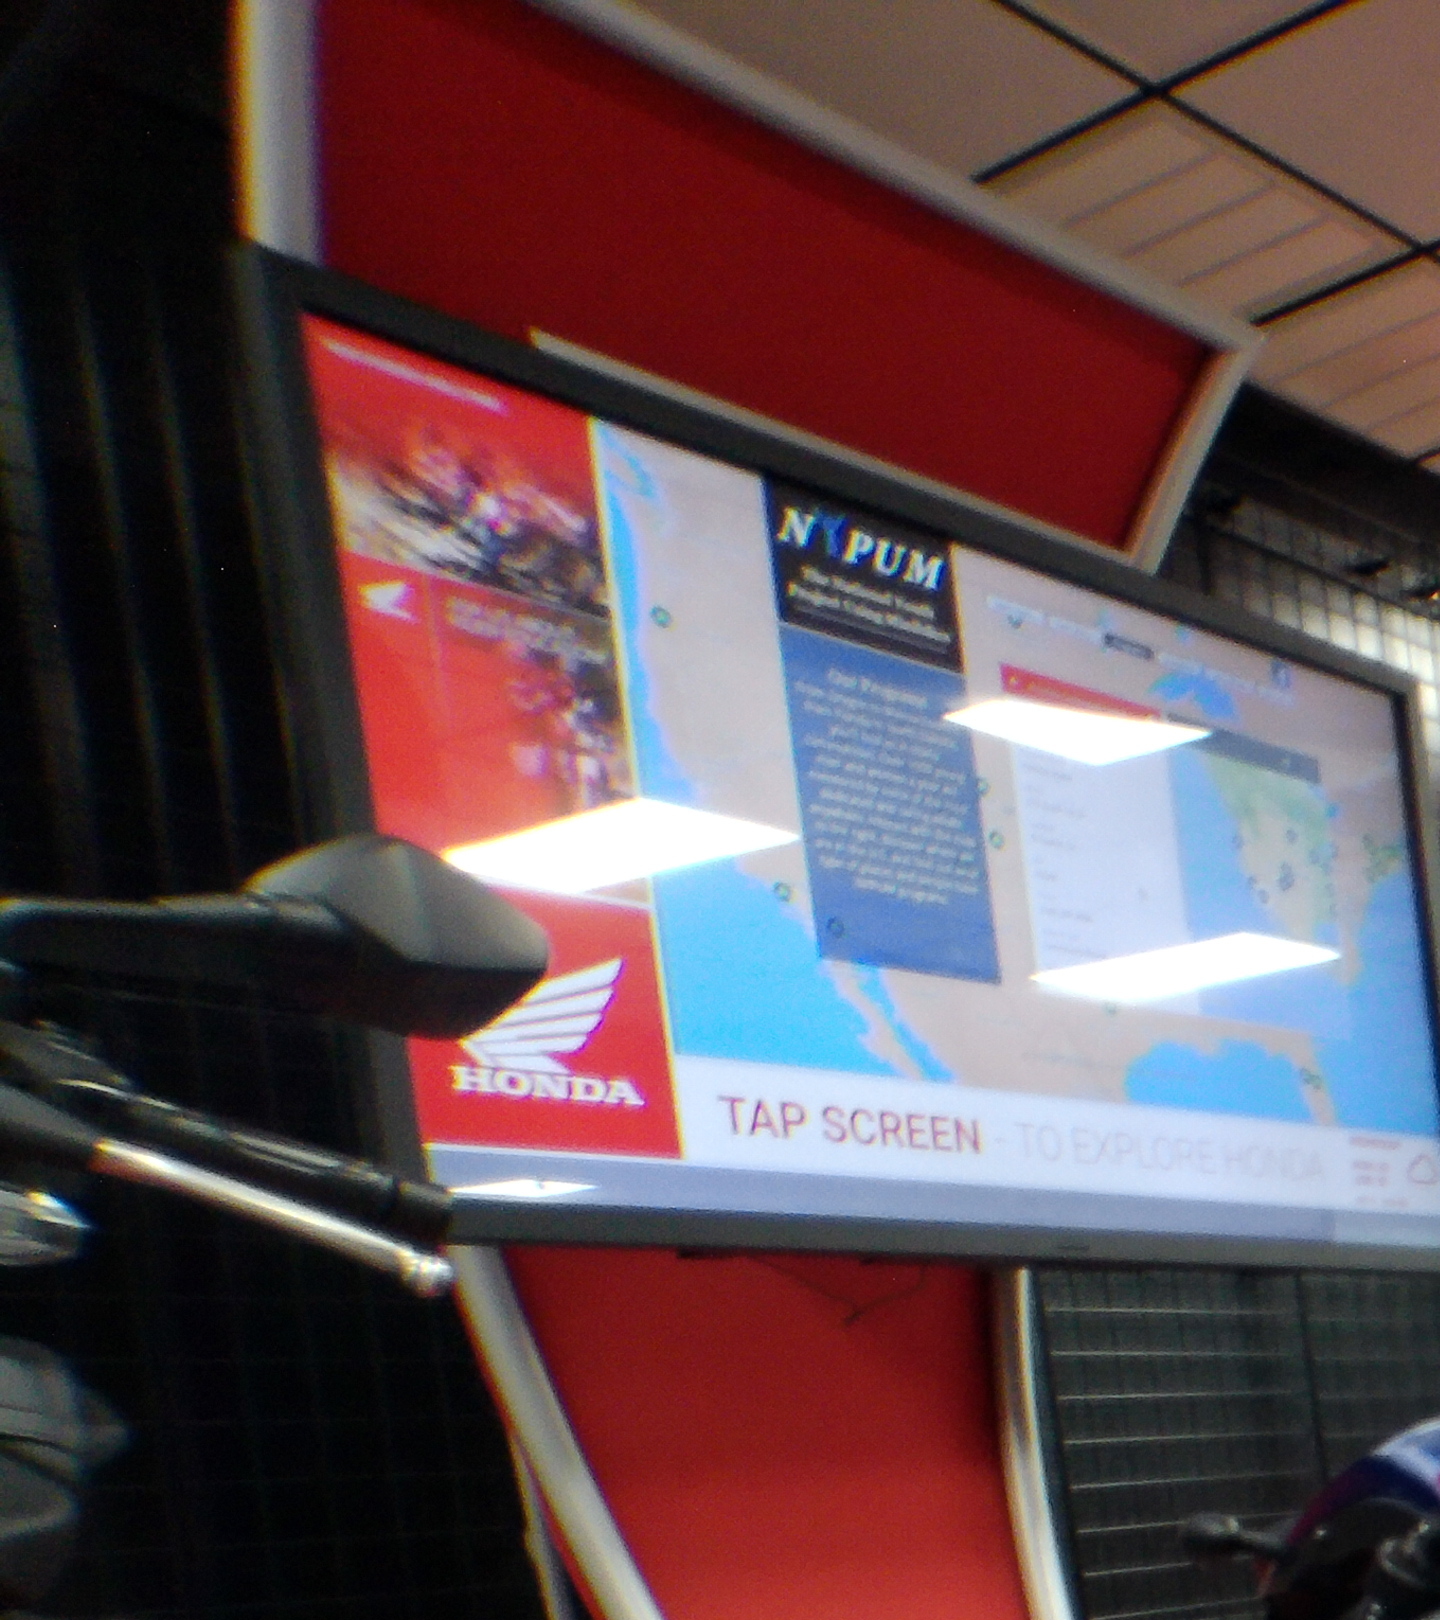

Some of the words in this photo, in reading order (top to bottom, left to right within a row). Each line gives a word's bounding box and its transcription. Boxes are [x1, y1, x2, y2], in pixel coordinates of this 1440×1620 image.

[777, 506, 946, 591] NYPUM
[450, 1065, 647, 1106] HONDA
[717, 1095, 807, 1139] TAP
[821, 1105, 985, 1154] SCREEN
[1015, 1121, 1063, 1165] TO
[1070, 1126, 1217, 1175] EXPLORE
